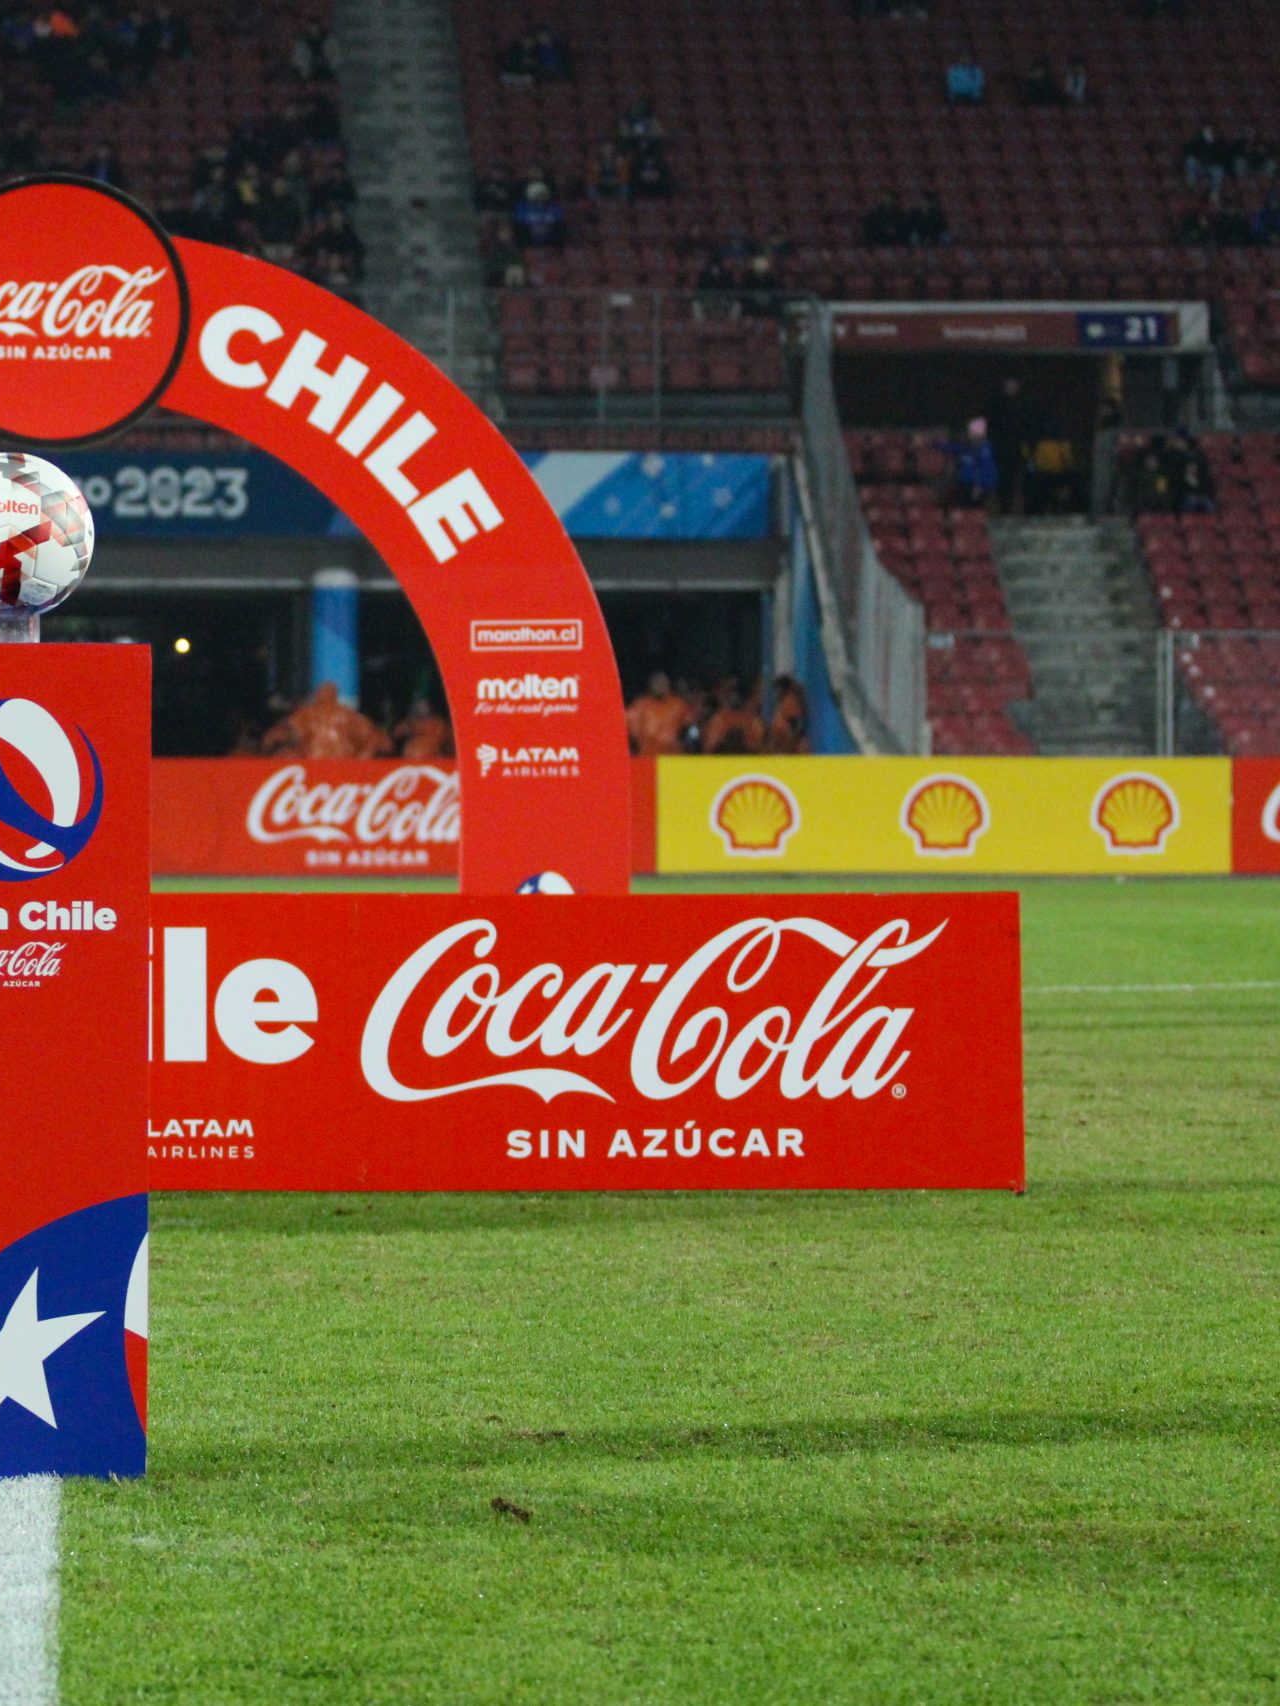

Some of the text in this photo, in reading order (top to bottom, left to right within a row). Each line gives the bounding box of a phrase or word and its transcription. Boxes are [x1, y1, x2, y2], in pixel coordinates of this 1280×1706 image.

[33, 343, 111, 359] AZÚCAR
[198, 304, 504, 564] CHILE
[477, 627, 576, 642] marathon.cl
[477, 673, 579, 699] molten
[502, 747, 579, 762] LATAM
[502, 766, 580, 777] AIRLINES
[246, 764, 460, 843] Coca-Cola
[19, 901, 117, 930] Chile
[3, 979, 41, 987] AZÚCAR
[360, 917, 949, 1103] Coca-Cola
[148, 1119, 254, 1137] LATAM
[506, 1121, 805, 1159] SIN AZÚCAR
[148, 1146, 255, 1158] AIRLINES
